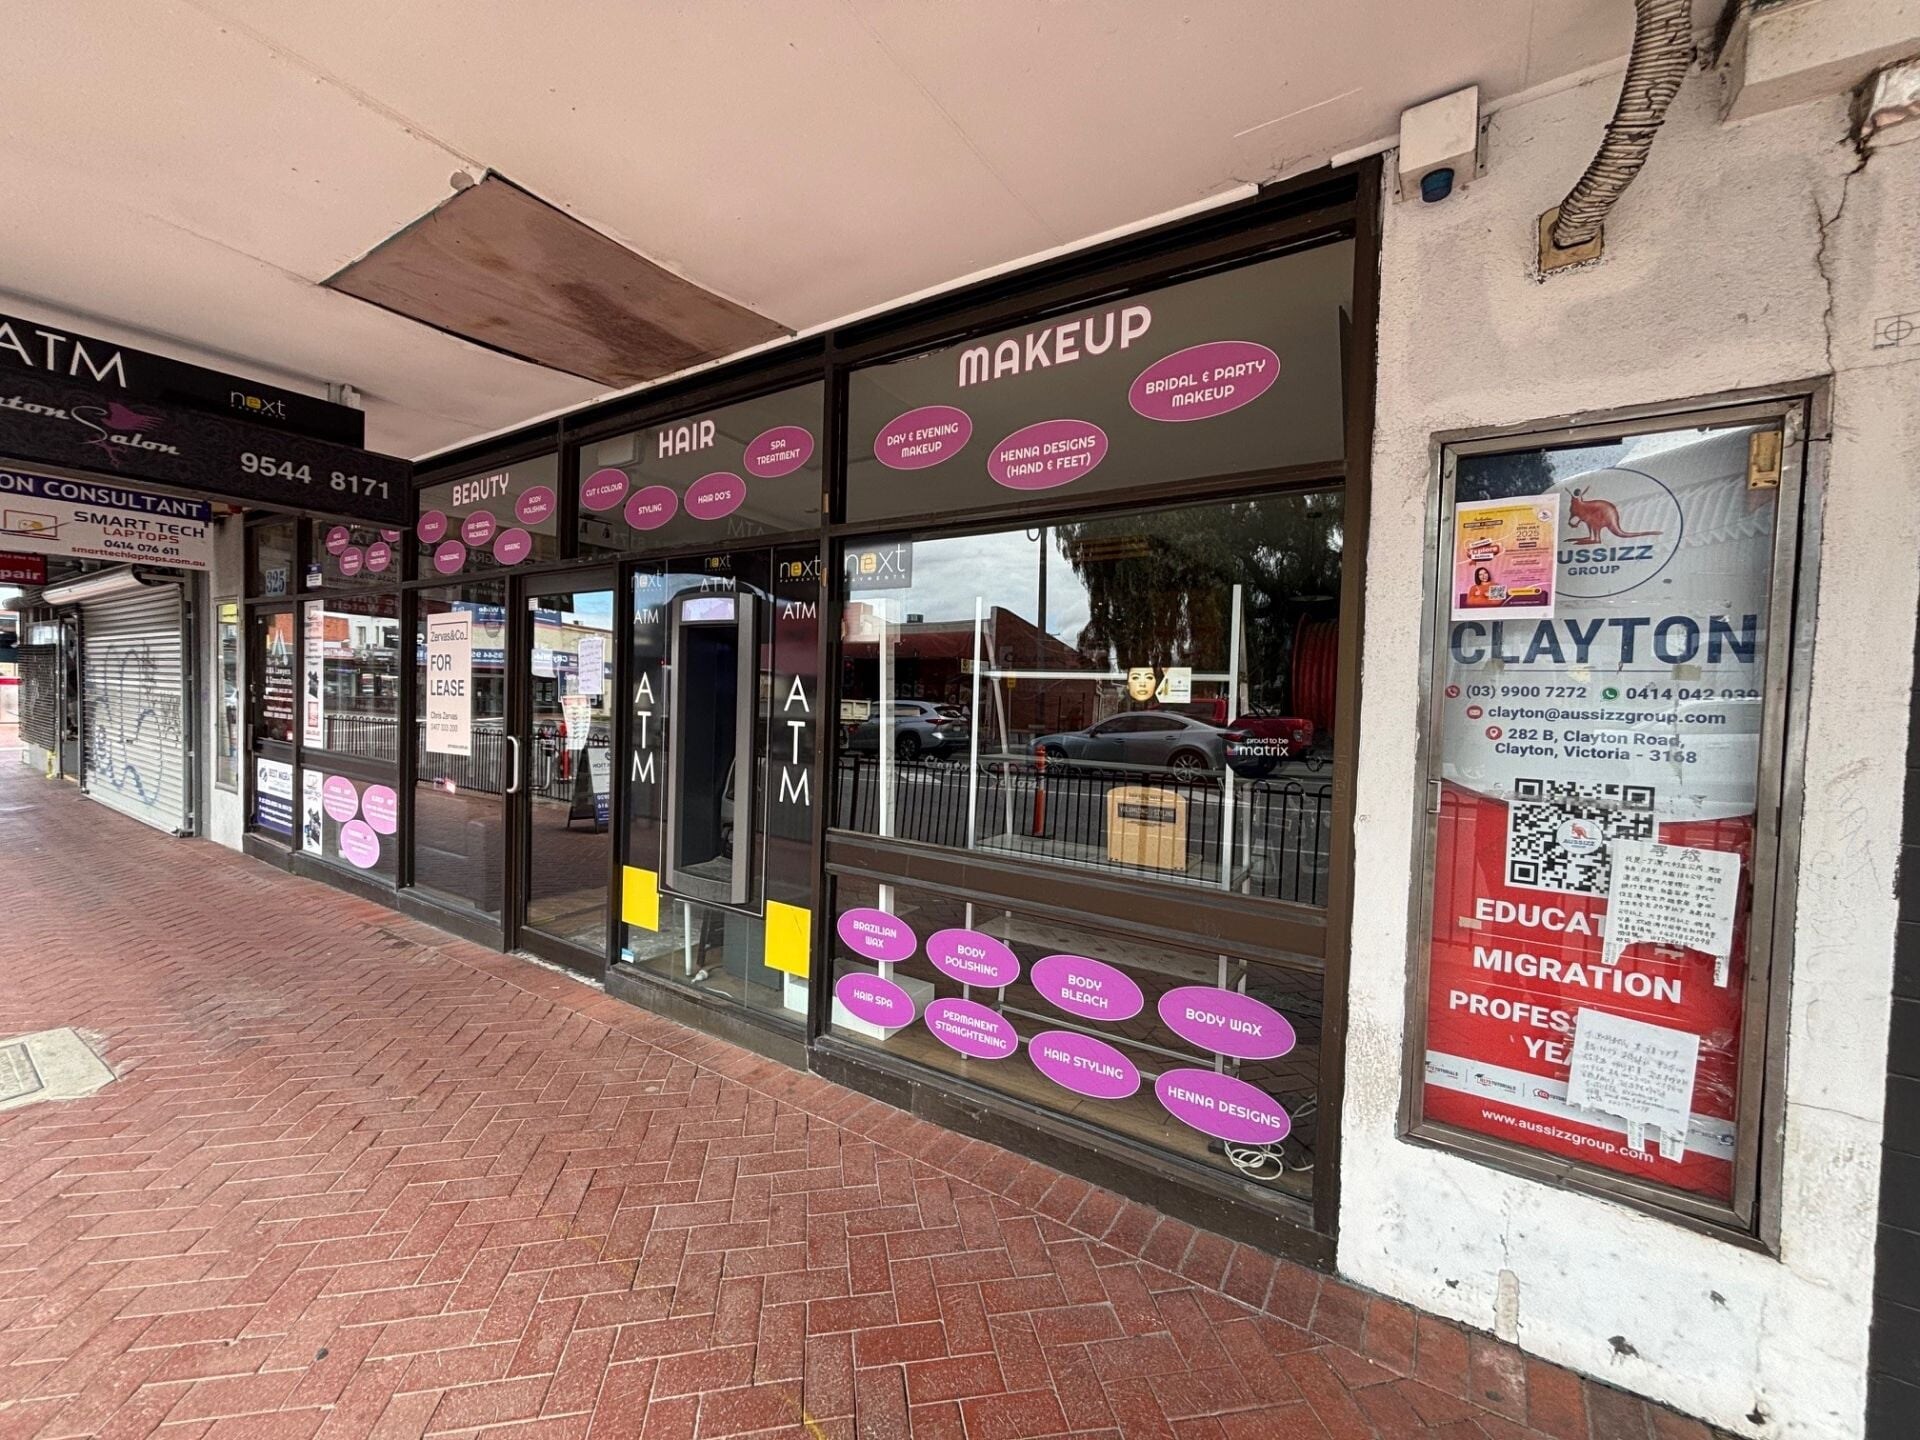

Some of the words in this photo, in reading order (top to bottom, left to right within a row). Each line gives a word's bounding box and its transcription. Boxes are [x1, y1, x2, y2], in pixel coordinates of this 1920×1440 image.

[0, 322, 127, 388] ATM
[957, 305, 1153, 388] MAKEUP
[1145, 373, 1198, 395] BRIDAL
[1201, 371, 1210, 384] &
[1213, 359, 1266, 382] PARTY
[1171, 384, 1235, 408] MAKEUP
[0, 396, 70, 420] ton
[71, 405, 180, 455] Salon
[886, 433, 906, 447] DAY
[915, 422, 959, 439] EVENING
[658, 419, 716, 459] HAIR
[770, 439, 786, 451] SPA
[901, 441, 942, 458] MAKEUP
[1000, 445, 1040, 463] HENNA
[1043, 435, 1096, 455] DESIGNS
[756, 448, 800, 466] TREATMENT
[1006, 461, 1044, 478] (HAND
[1055, 452, 1091, 470] FEET)
[240, 452, 312, 484] 9544
[330, 471, 389, 500] 8171
[43, 481, 202, 517] CONSULTANT
[452, 472, 509, 507] BEAUTY
[585, 488, 597, 497] CUT
[698, 494, 714, 504] HAIR
[638, 503, 662, 515] STYLING
[75, 511, 151, 531] SMART
[151, 522, 204, 538] TECH
[103, 527, 179, 544] LAPTOPS
[104, 539, 134, 551] 0414
[138, 543, 159, 553] 076
[162, 545, 180, 556] 611
[1557, 545, 1653, 564] USSIZZ
[779, 555, 821, 579] next
[844, 543, 906, 576] next
[1568, 565, 1620, 576] GROUP
[266, 570, 286, 593] 325
[700, 576, 738, 593] ATM
[633, 608, 659, 625] ATM
[782, 601, 816, 620] ATM
[1451, 614, 1757, 664] CLAYTON
[430, 654, 452, 671] FOR
[430, 679, 465, 697] LEASE
[1466, 685, 1496, 699] (03)
[1501, 685, 1540, 698] 9900
[1545, 686, 1587, 699] 7272
[1626, 687, 1674, 700] 0414
[1678, 687, 1715, 700] 042
[1488, 706, 1727, 726] clayton@aussizzgroup.com
[631, 671, 655, 784] ATM
[778, 674, 810, 807] ATM
[1246, 737, 1269, 745] proud
[1508, 728, 1538, 741] 282
[1542, 729, 1558, 744] B,
[1563, 729, 1629, 747] Clayton
[1633, 733, 1685, 749] Road,
[1239, 745, 1289, 757] matrix
[1495, 743, 1558, 759] Clayton,
[1564, 745, 1631, 761] Victoria
[1649, 749, 1698, 764] 3168
[925, 755, 971, 775] Clayto
[1475, 897, 1607, 937] EDUCAT
[853, 920, 897, 939] BRAZILIAN
[865, 935, 884, 948] WAX
[957, 944, 986, 960] BODY
[945, 956, 999, 977] POLISHING
[1473, 946, 1682, 1004] MIGRATION
[1067, 974, 1102, 991] BODY
[853, 989, 874, 1003] HAIR
[875, 995, 893, 1009] SPA
[1061, 988, 1108, 1009] BLEACH
[943, 1009, 999, 1033] PERMANENT
[1450, 989, 1578, 1033] PROFES
[1185, 1008, 1226, 1027] BODY
[1229, 1018, 1263, 1037] WAX
[935, 1020, 1007, 1050] STRAIGHTENING
[1044, 1047, 1071, 1065] HAIR
[1073, 1056, 1124, 1080] STYLING
[1168, 1085, 1215, 1110] HENNA
[1218, 1100, 1281, 1129] DESIGNS
[1482, 1109, 1655, 1163] www.aussizzgroup.com
